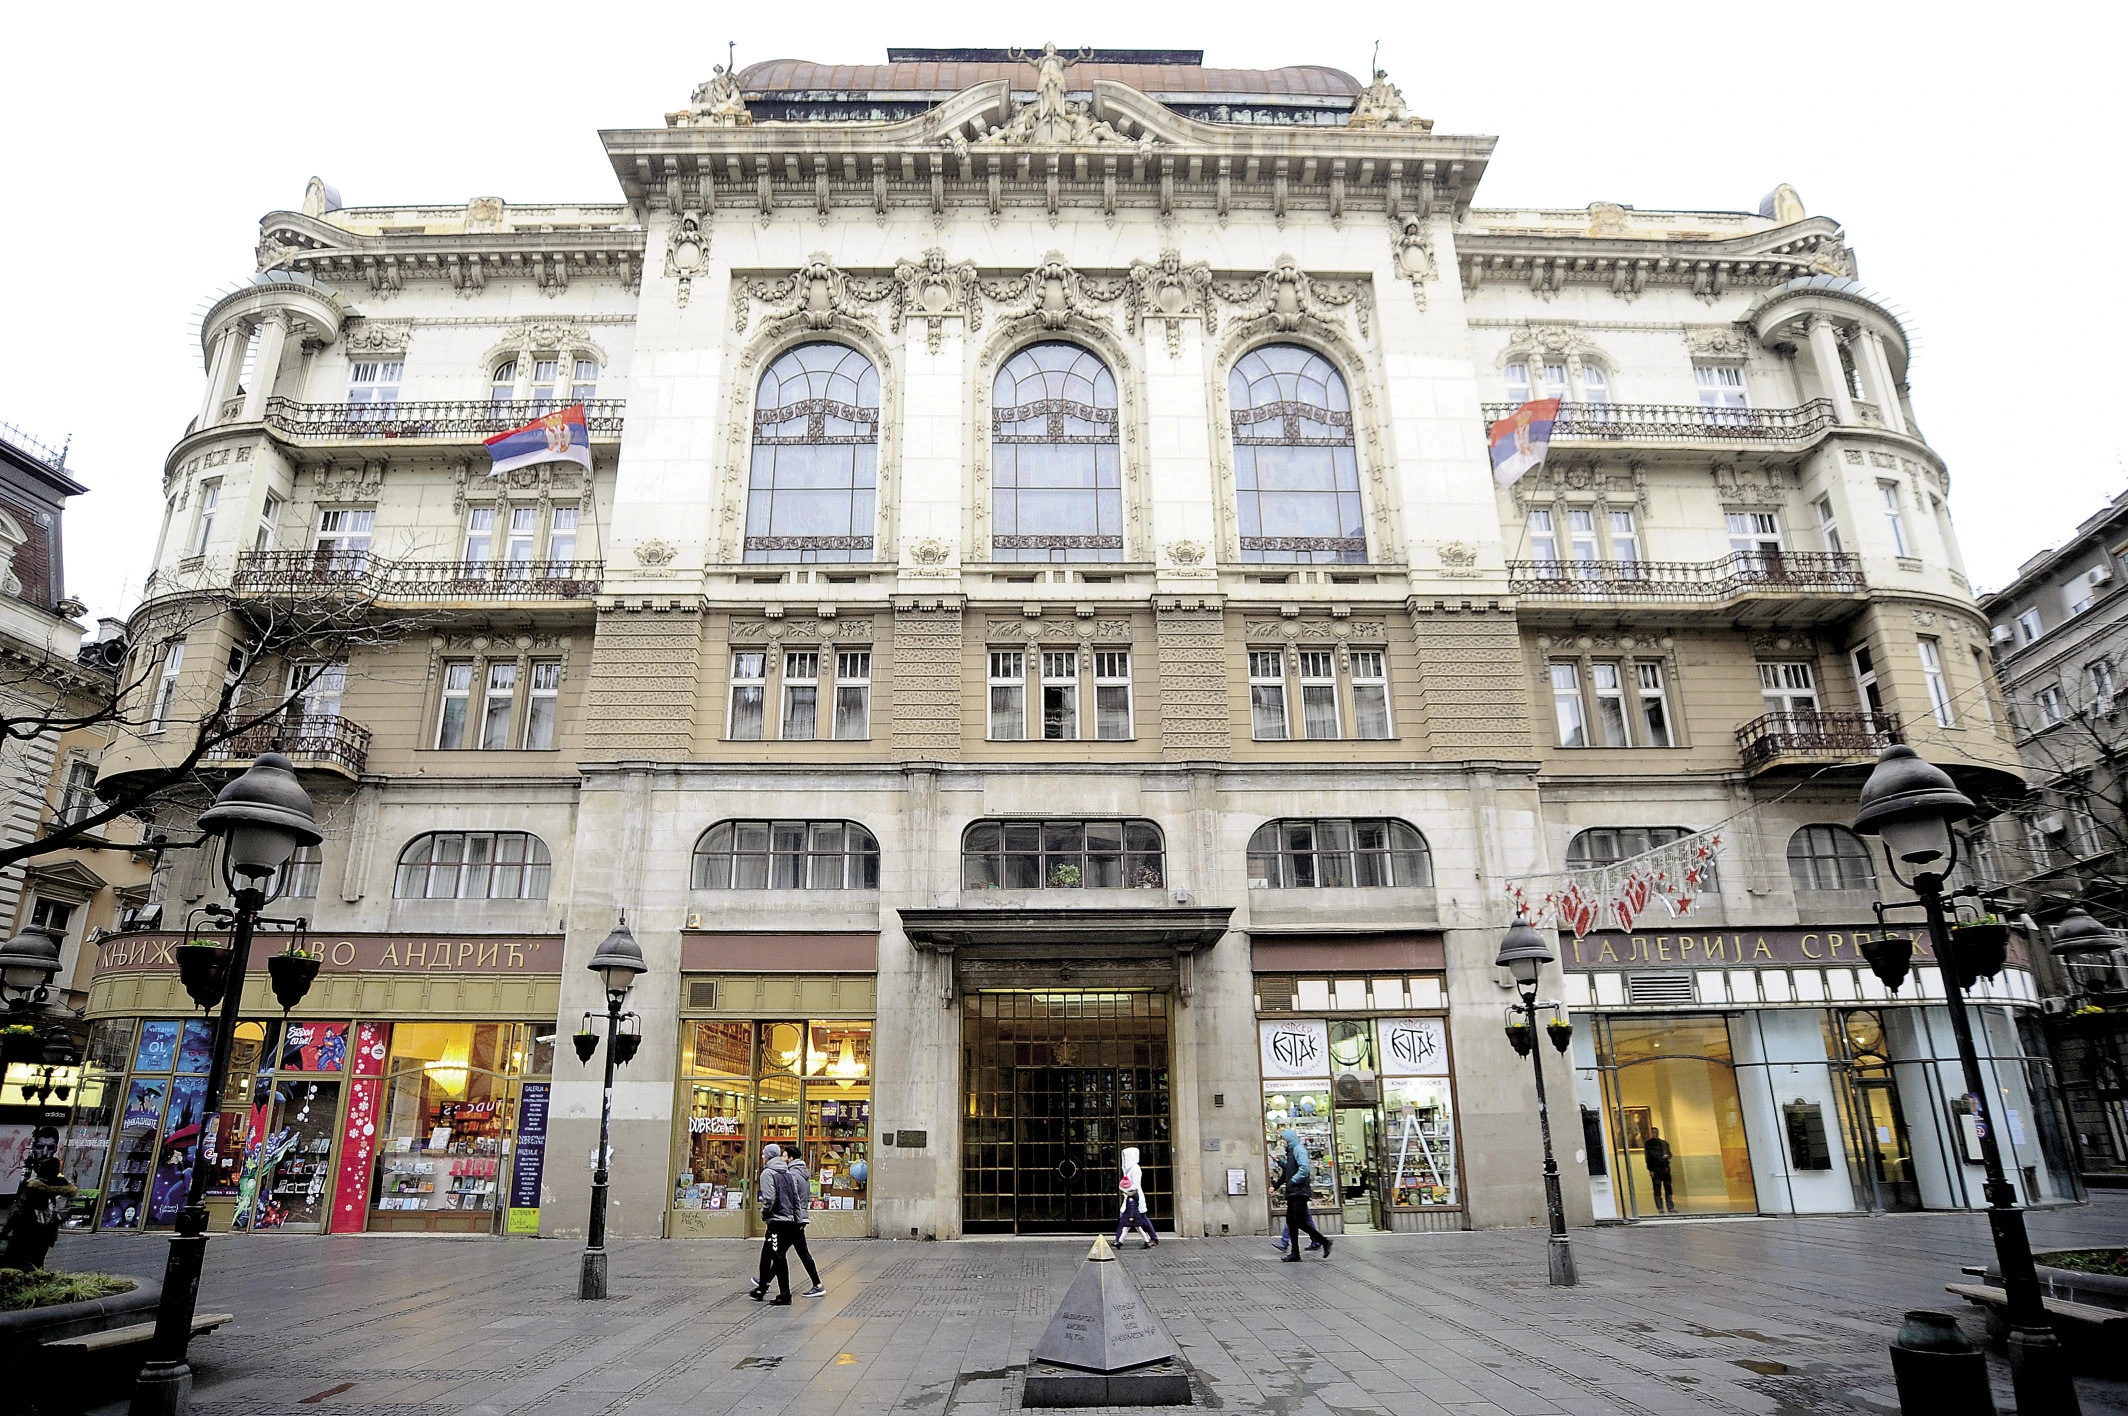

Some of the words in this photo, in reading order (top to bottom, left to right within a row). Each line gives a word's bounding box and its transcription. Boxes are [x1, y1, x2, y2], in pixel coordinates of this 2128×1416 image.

[102, 939, 221, 968] КЊИЖ
[1572, 935, 1773, 963] ГАЛЕРИЈА
[1800, 931, 1929, 959] СРПК
[1273, 1031, 1319, 1067] КУТАК
[1391, 1028, 1437, 1064] КУТАК
[688, 1116, 716, 1134] DOBRE
